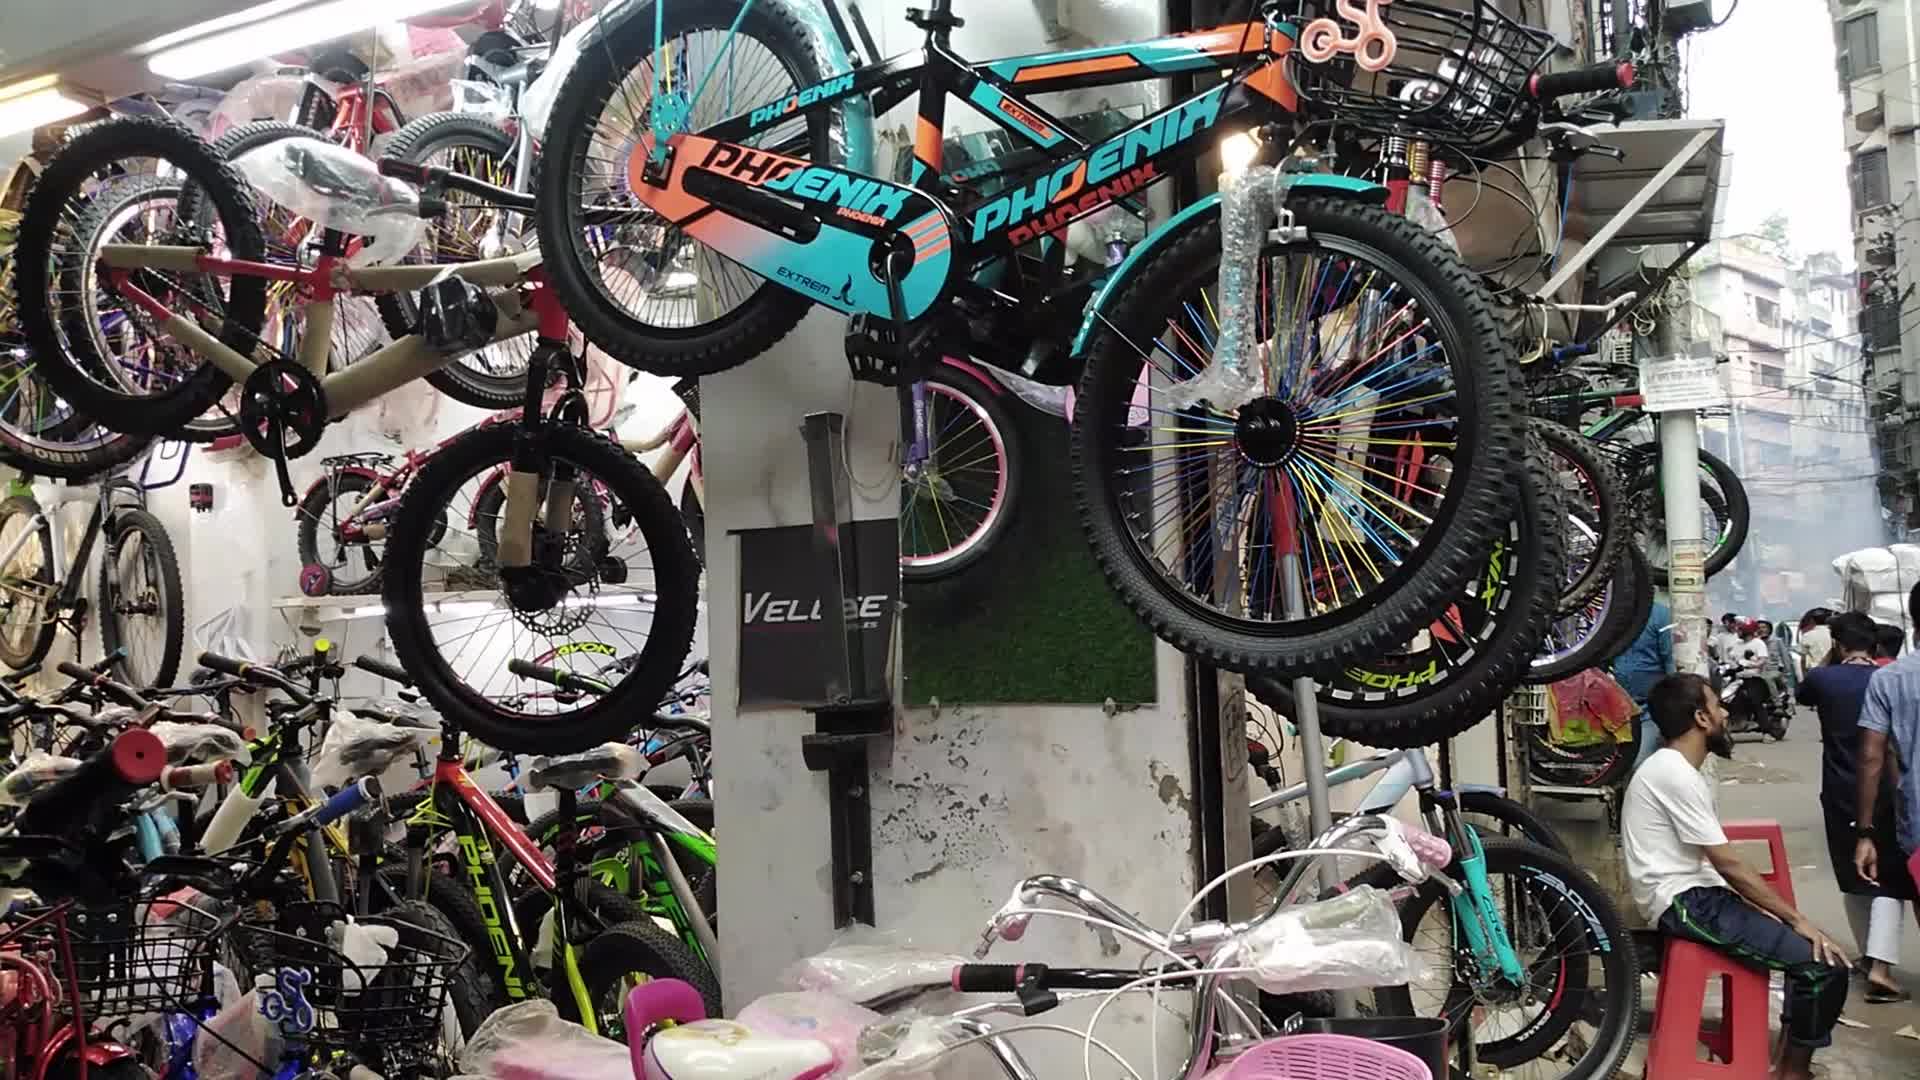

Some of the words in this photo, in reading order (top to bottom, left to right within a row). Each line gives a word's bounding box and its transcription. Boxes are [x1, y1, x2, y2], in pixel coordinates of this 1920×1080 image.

[750, 73, 855, 128] PHOENIX
[701, 143, 913, 221] PHOENIX
[973, 88, 1227, 242] PHOENIX
[836, 207, 887, 227] PHOENIX
[776, 266, 832, 295] EXTREM
[34, 447, 89, 463] HERO
